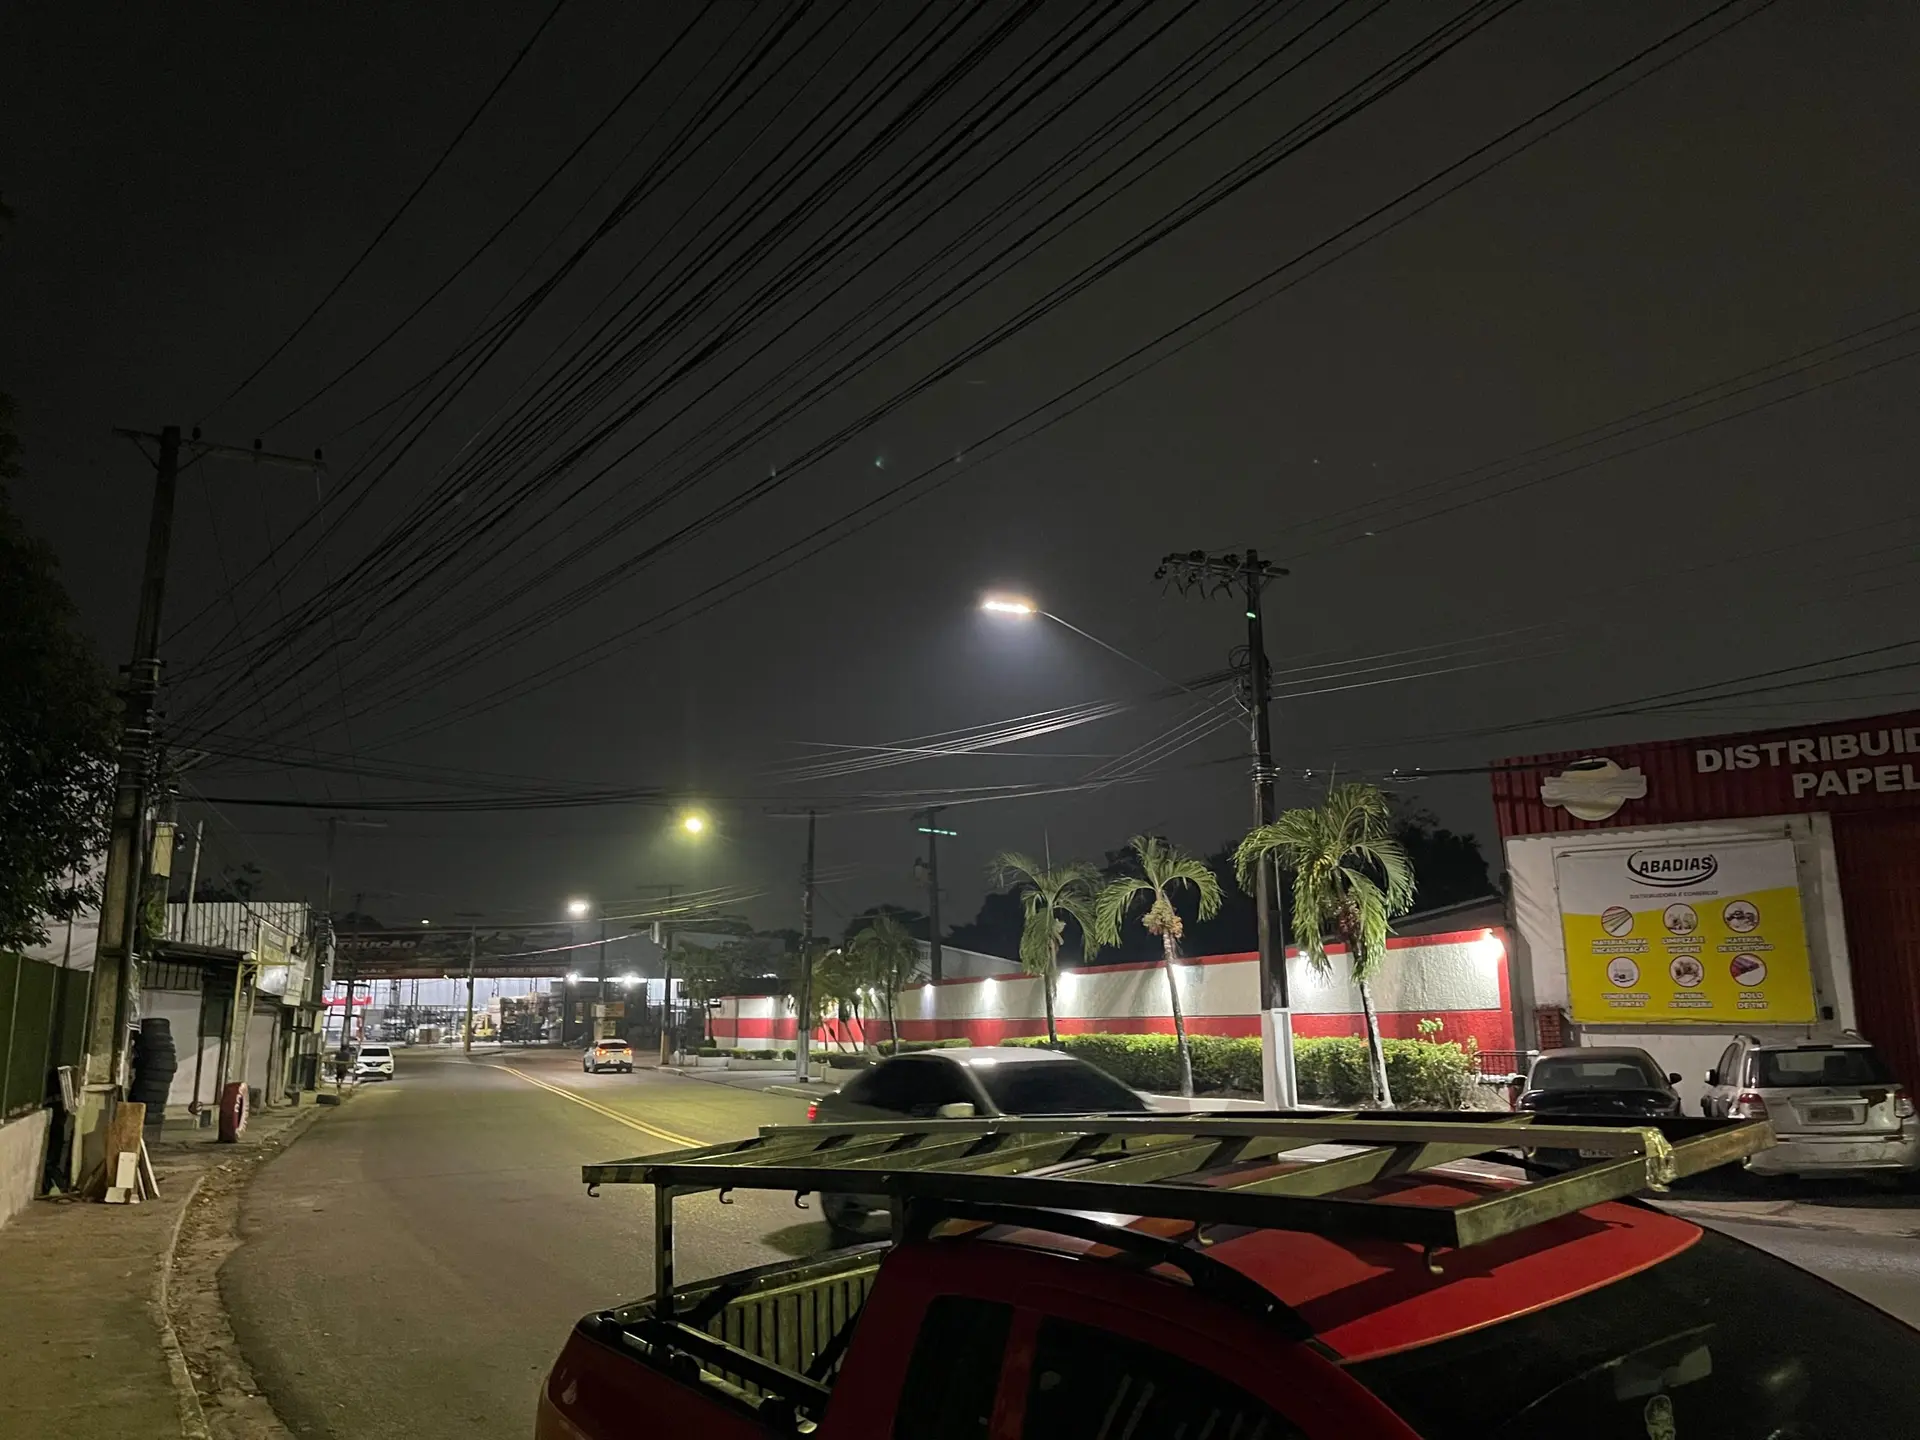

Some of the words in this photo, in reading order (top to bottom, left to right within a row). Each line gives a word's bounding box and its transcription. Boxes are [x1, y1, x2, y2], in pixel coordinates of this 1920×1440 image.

[1791, 764, 1920, 799] PAPEL
[1639, 857, 1713, 874] ABADIAS
[1725, 936, 1764, 944] MATERIAL
